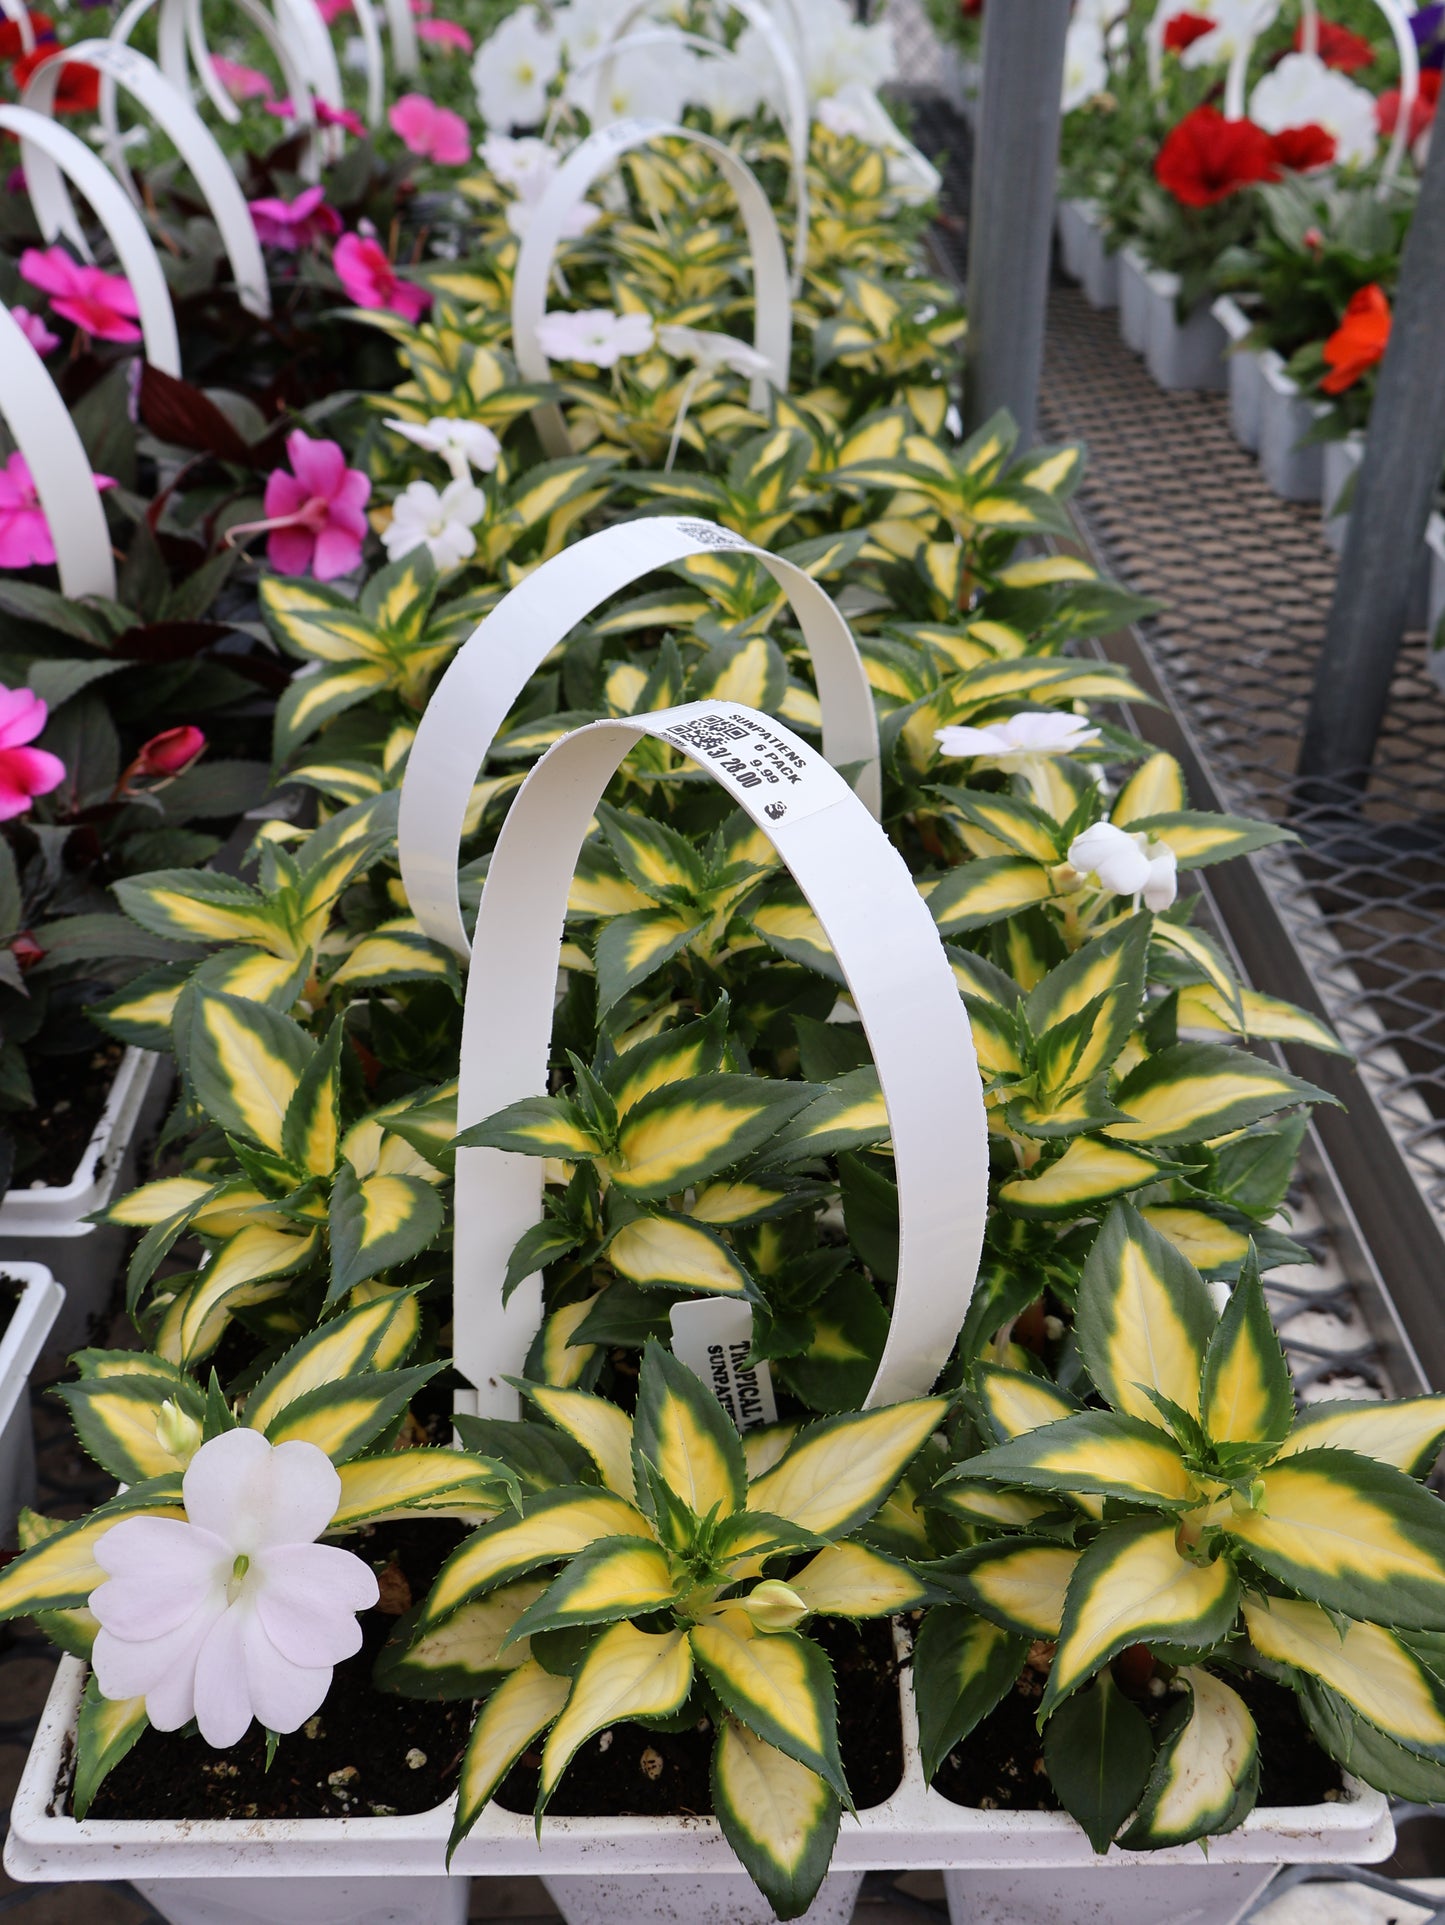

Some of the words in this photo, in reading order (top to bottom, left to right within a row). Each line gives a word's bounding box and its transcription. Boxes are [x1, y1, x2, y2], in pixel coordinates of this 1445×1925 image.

[728, 713, 807, 769] SUNPATIENS
[707, 747, 732, 759] 3/
[720, 757, 763, 789] 28.00
[749, 758, 780, 784] 9.99
[753, 743, 765, 752] 6
[764, 752, 803, 785] PACK
[707, 1344, 739, 1429] SUNPATI
